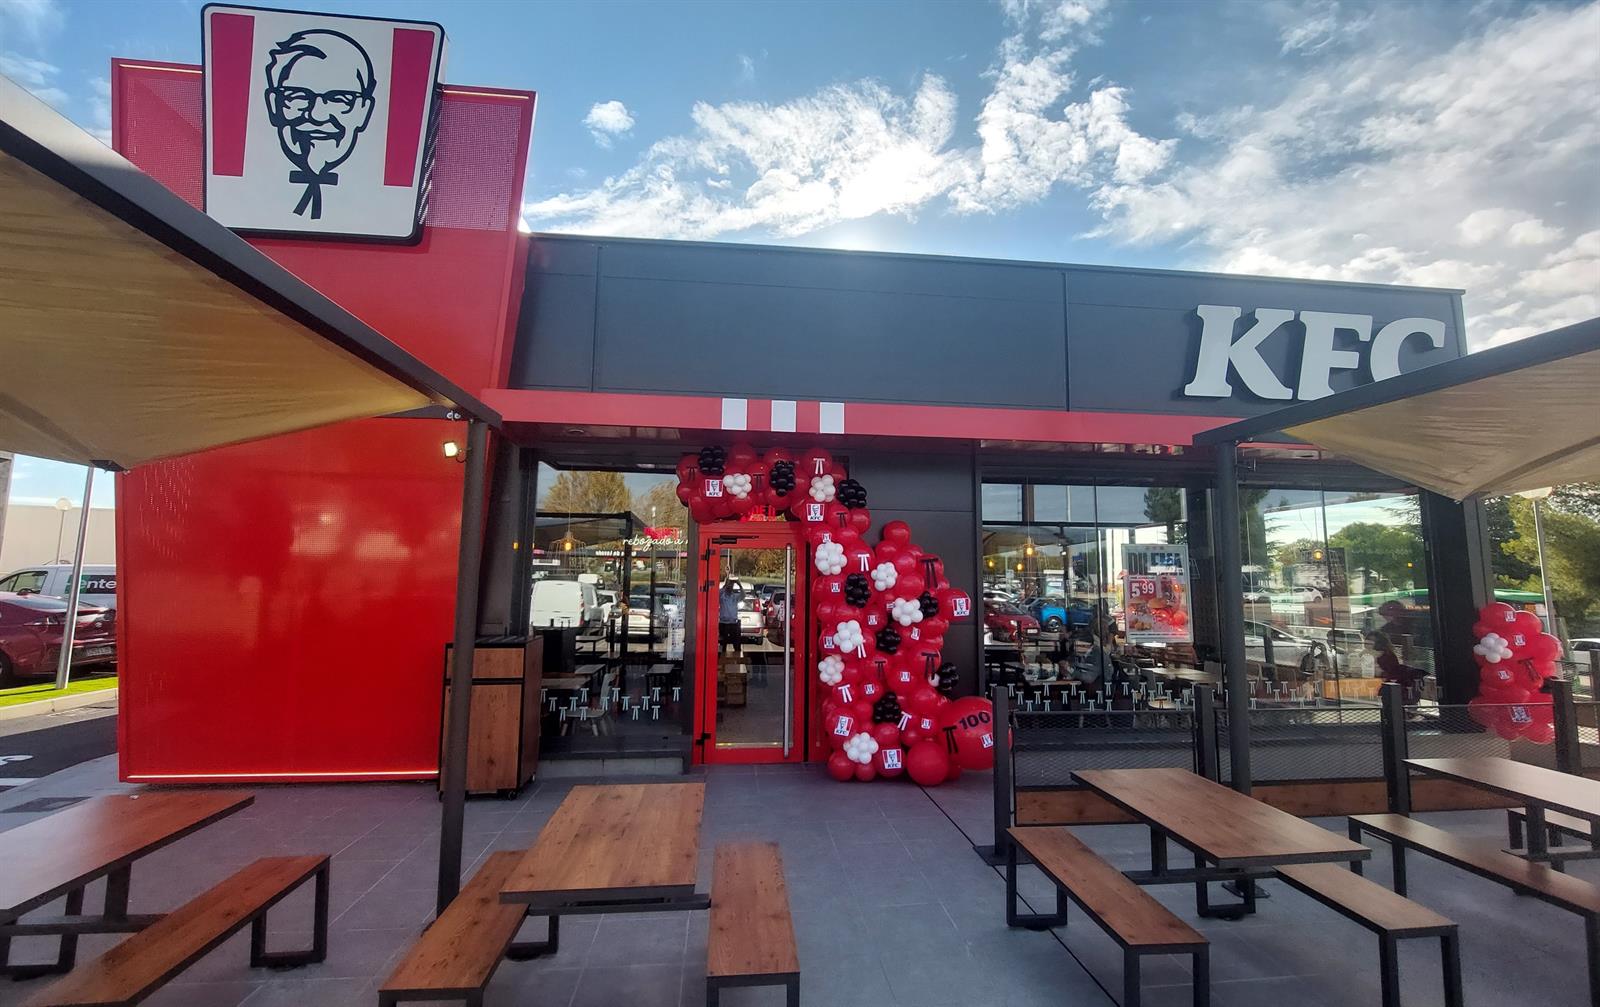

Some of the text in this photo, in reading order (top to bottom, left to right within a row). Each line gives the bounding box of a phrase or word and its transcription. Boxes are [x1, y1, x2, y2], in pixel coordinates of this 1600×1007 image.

[1184, 304, 1446, 401] KFC
[623, 535, 672, 552] rebozado
[959, 711, 991, 730] 100
